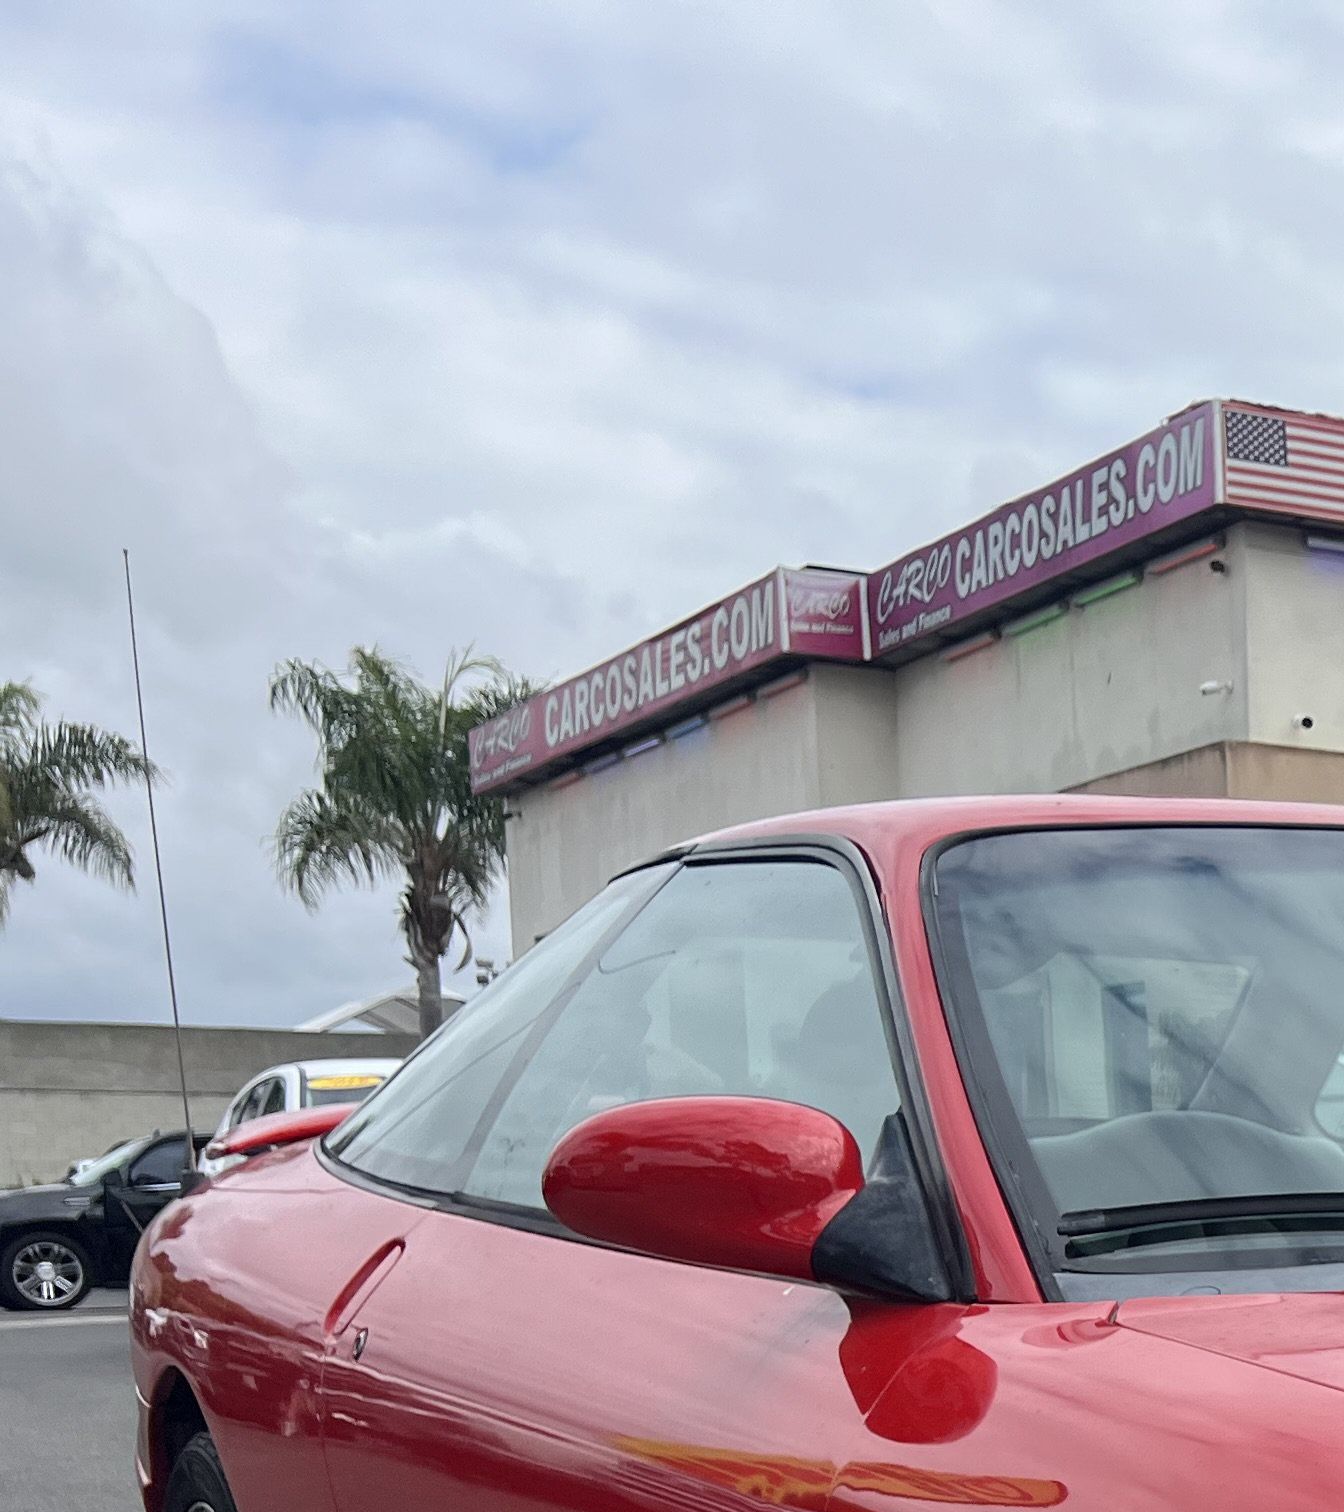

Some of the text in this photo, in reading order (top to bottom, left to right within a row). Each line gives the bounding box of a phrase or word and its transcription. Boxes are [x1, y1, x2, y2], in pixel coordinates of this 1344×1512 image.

[877, 416, 1206, 625] CARCO CARCOSALES.COM
[543, 580, 776, 748] CARCOSALES.COM
